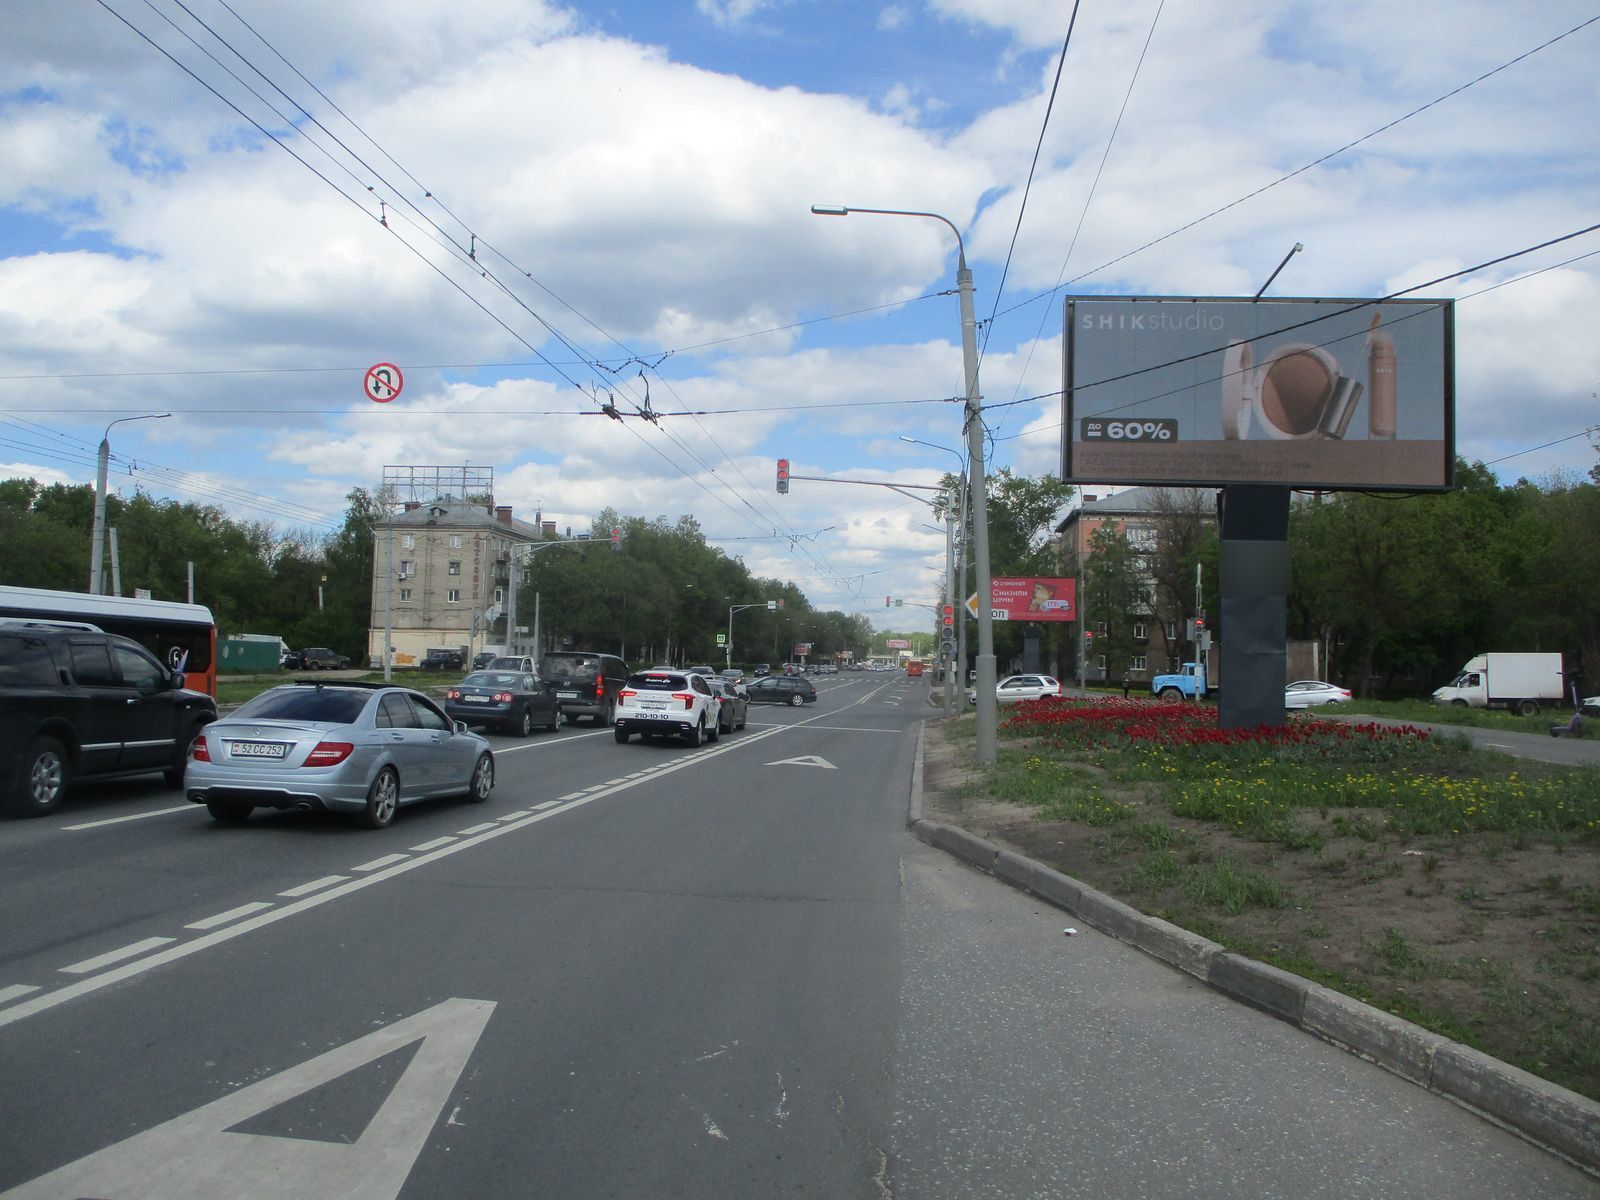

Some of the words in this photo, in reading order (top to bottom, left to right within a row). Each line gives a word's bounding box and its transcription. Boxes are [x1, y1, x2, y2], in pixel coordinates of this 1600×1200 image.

[992, 588, 1028, 596] Снизили
[634, 712, 669, 720] 210-10-10
[241, 744, 253, 754] 52
[253, 744, 266, 754] CC
[266, 745, 282, 755] 252
